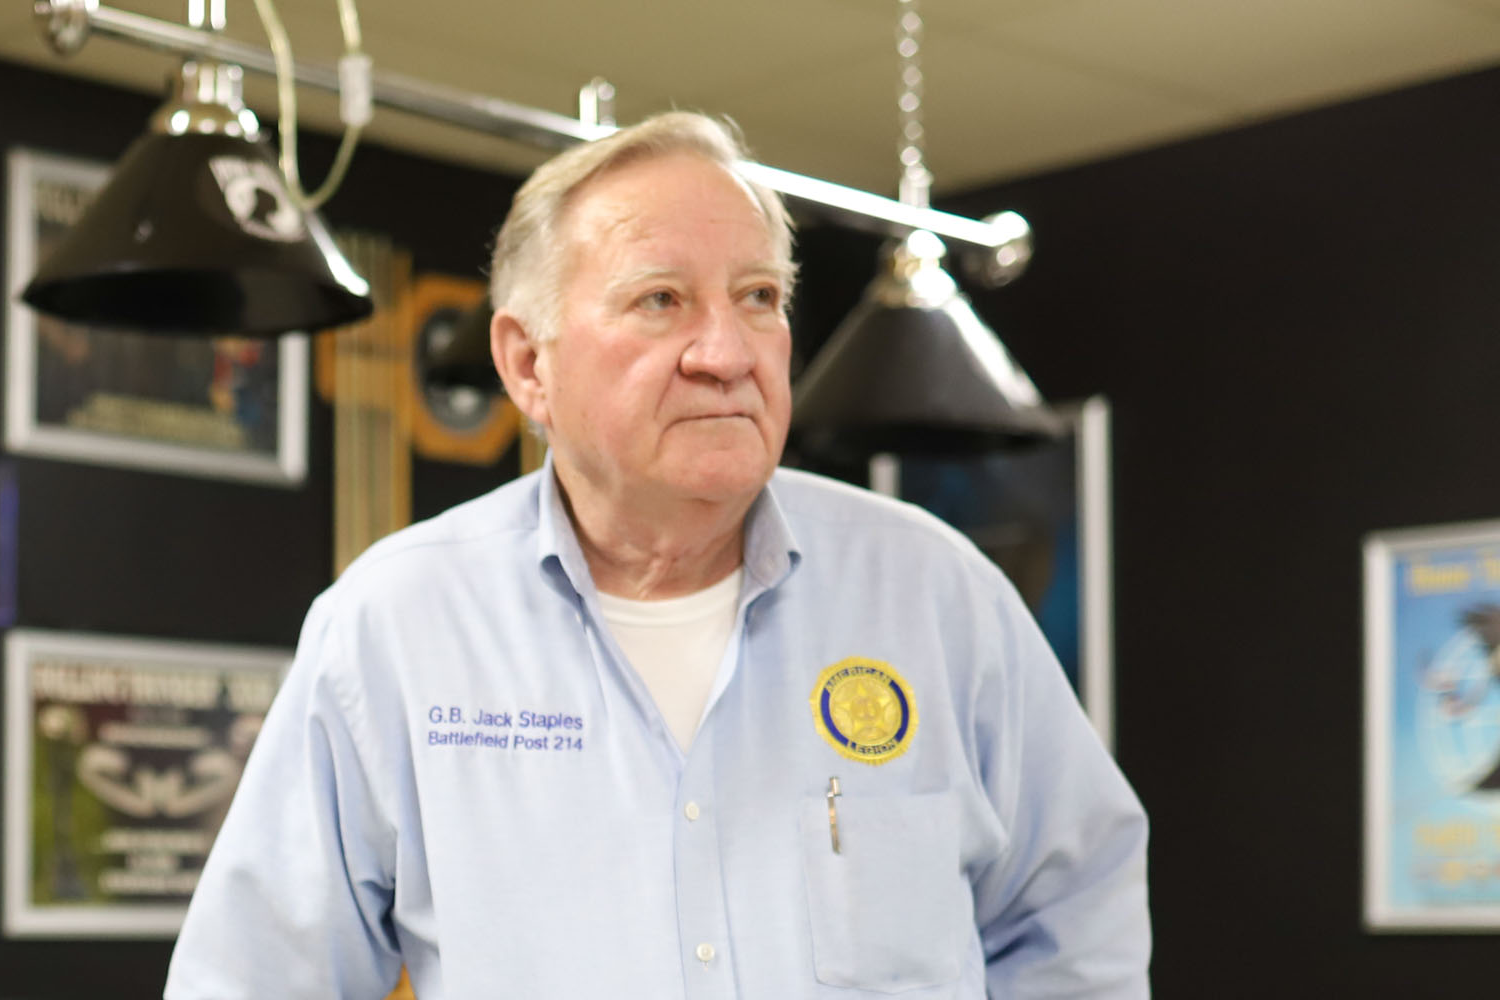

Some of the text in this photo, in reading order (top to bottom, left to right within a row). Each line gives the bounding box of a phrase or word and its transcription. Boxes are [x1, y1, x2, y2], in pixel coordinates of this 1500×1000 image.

[825, 665, 892, 692] AMERICAN
[428, 705, 584, 731] G.B. Jack Staples
[428, 731, 583, 752] Battlefield Post 214
[847, 738, 898, 756] LEGION
